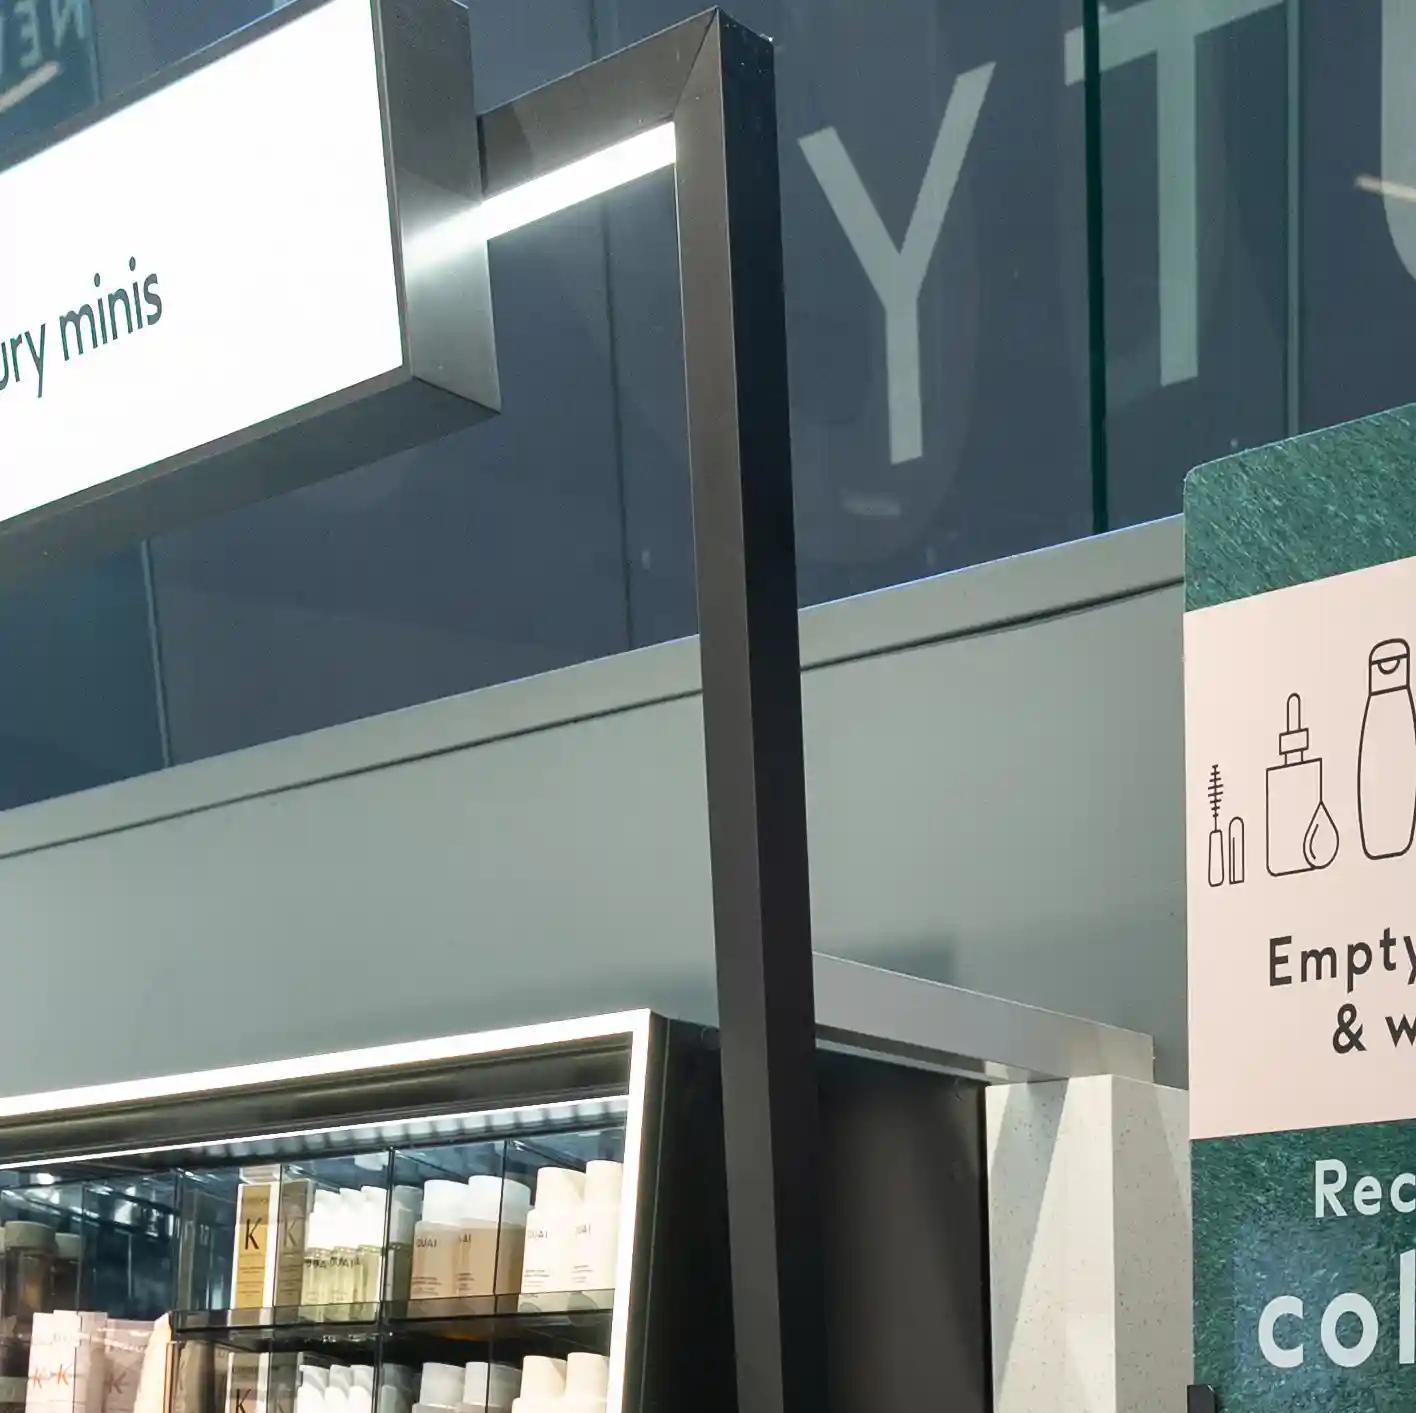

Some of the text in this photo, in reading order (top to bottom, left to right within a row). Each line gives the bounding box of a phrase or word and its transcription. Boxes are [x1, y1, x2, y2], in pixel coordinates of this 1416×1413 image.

[59, 255, 162, 362] minis
[1332, 1003, 1368, 1054] &
[245, 1218, 262, 1250] K
